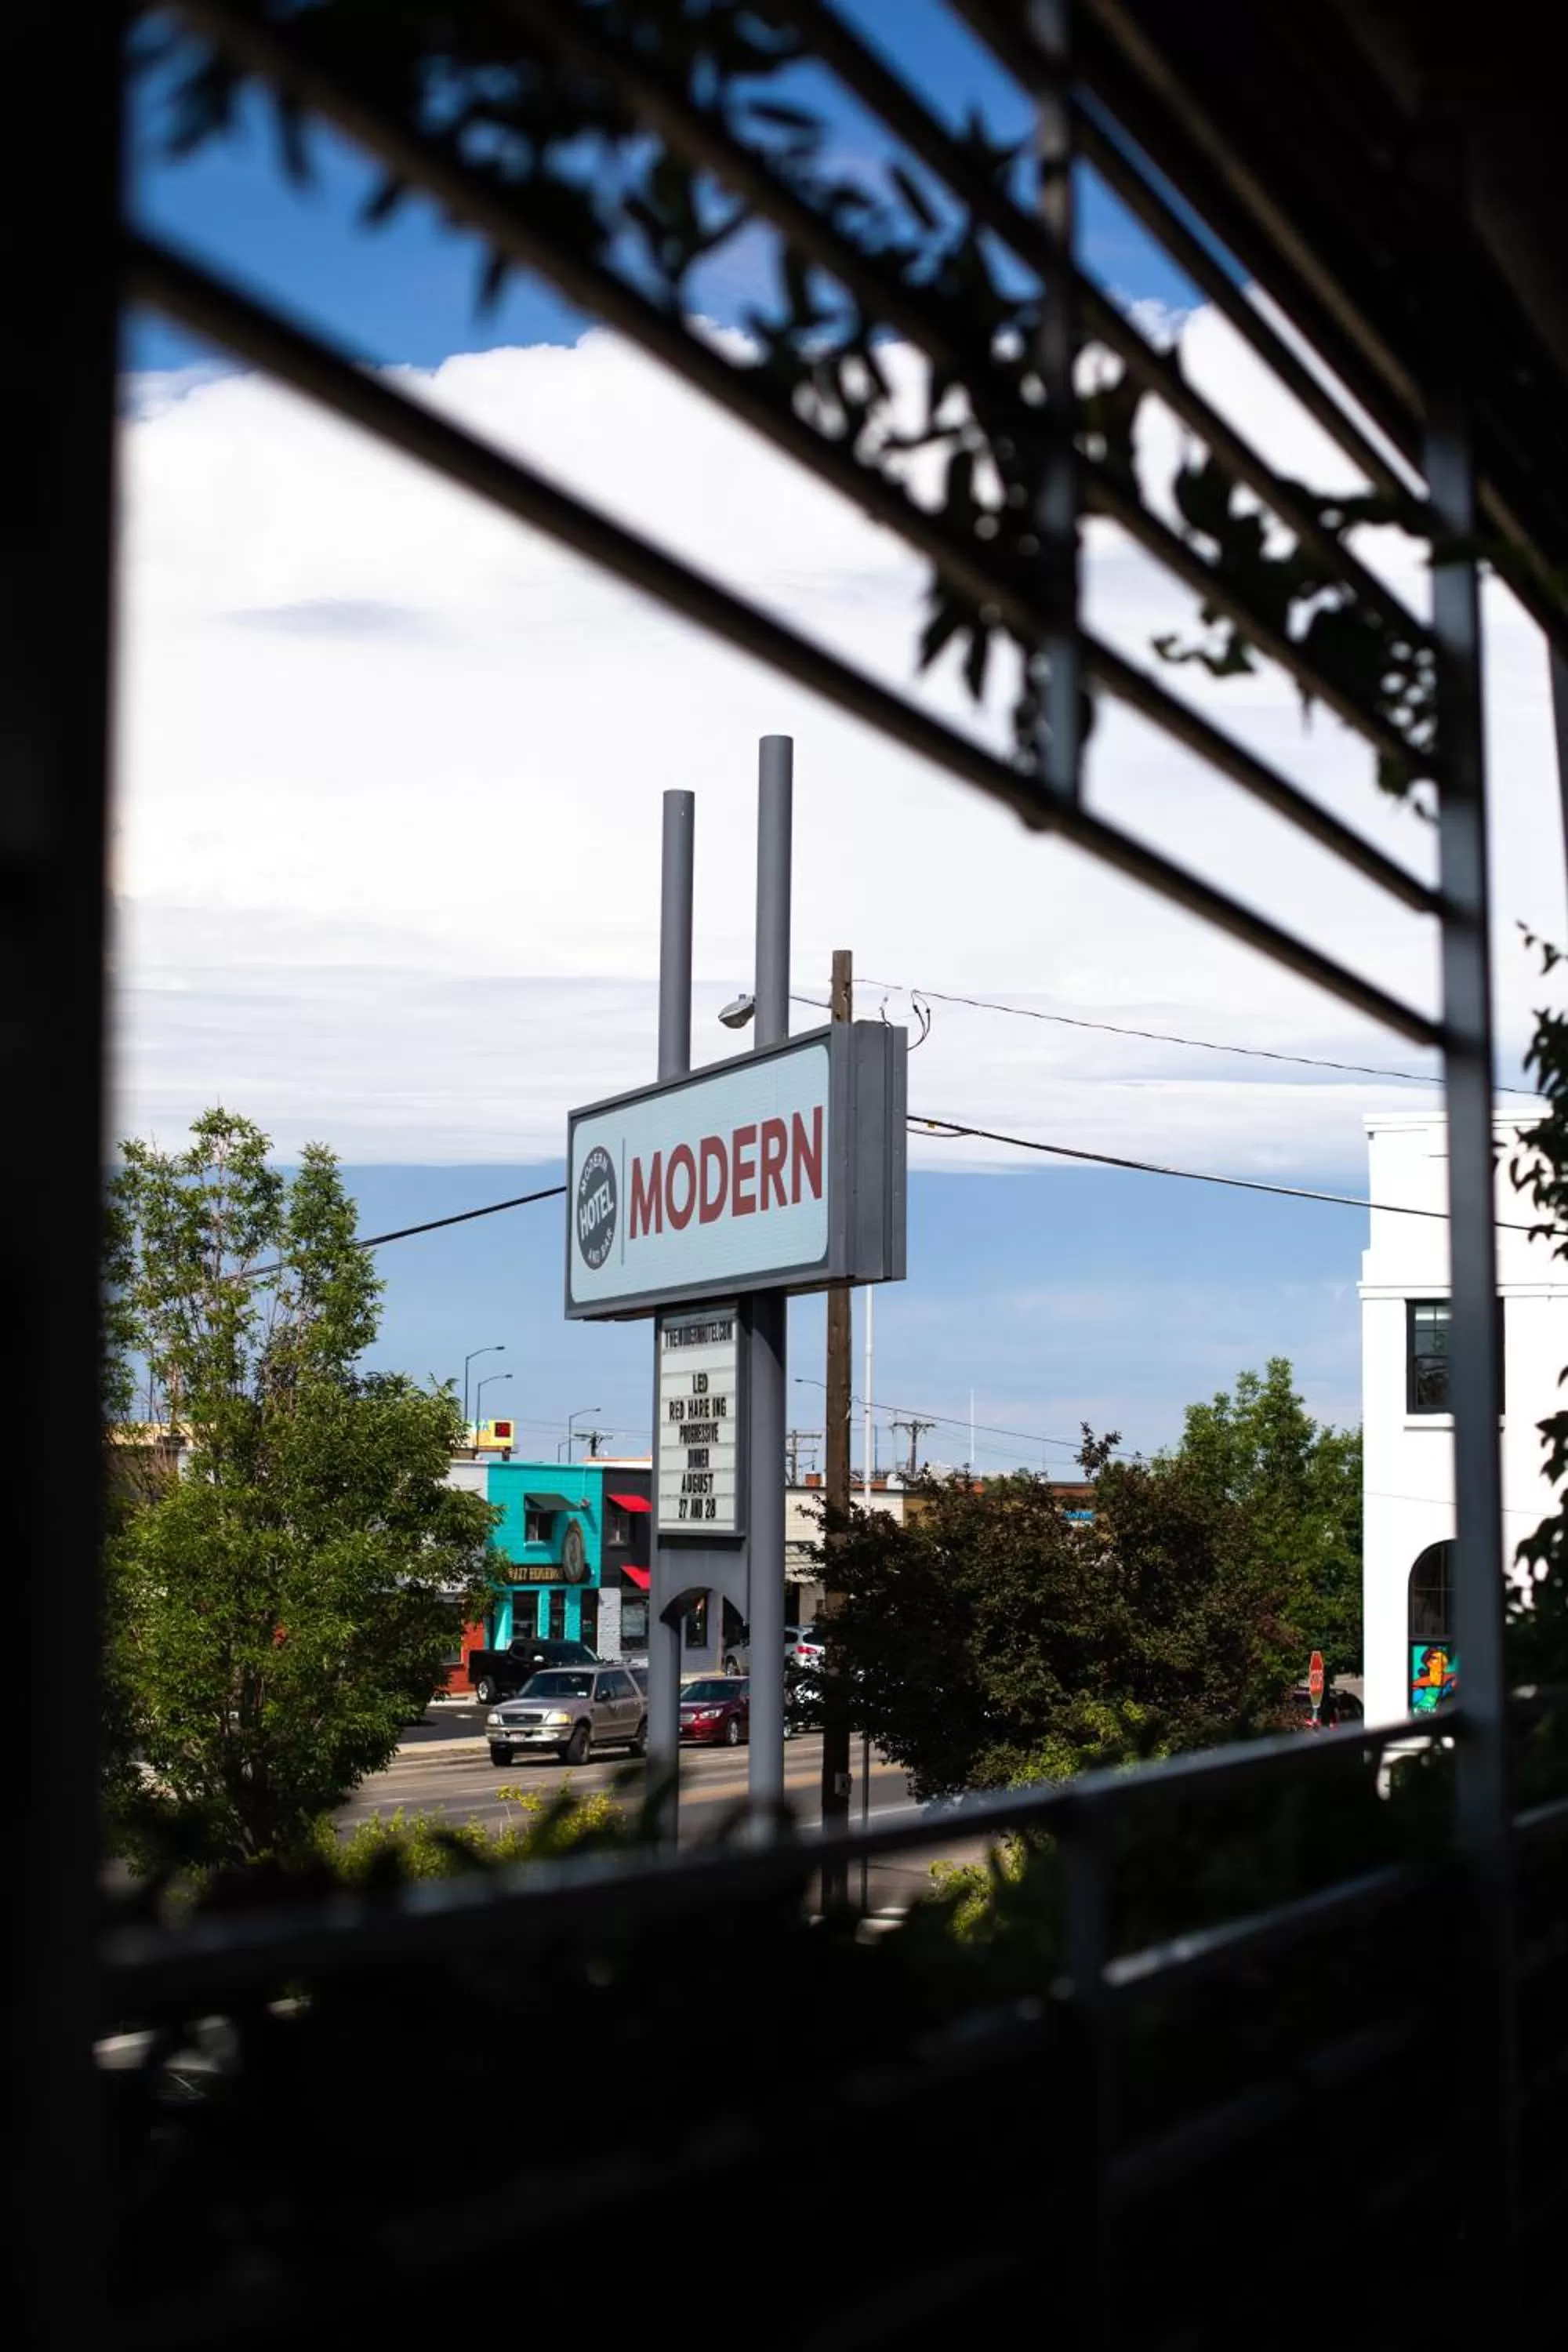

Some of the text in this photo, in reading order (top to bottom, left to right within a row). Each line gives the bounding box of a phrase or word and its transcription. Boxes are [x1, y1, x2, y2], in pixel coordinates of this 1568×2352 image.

[630, 1105, 822, 1240] MODERN
[579, 1180, 615, 1241] HOTEL
[692, 1373, 708, 1394] LED
[670, 1400, 684, 1421] RED
[688, 1398, 710, 1420] HARE
[679, 1421, 719, 1445] PROGRESSIVE
[681, 1472, 713, 1494] AUGUST
[678, 1497, 716, 1519] 27 AND 28
